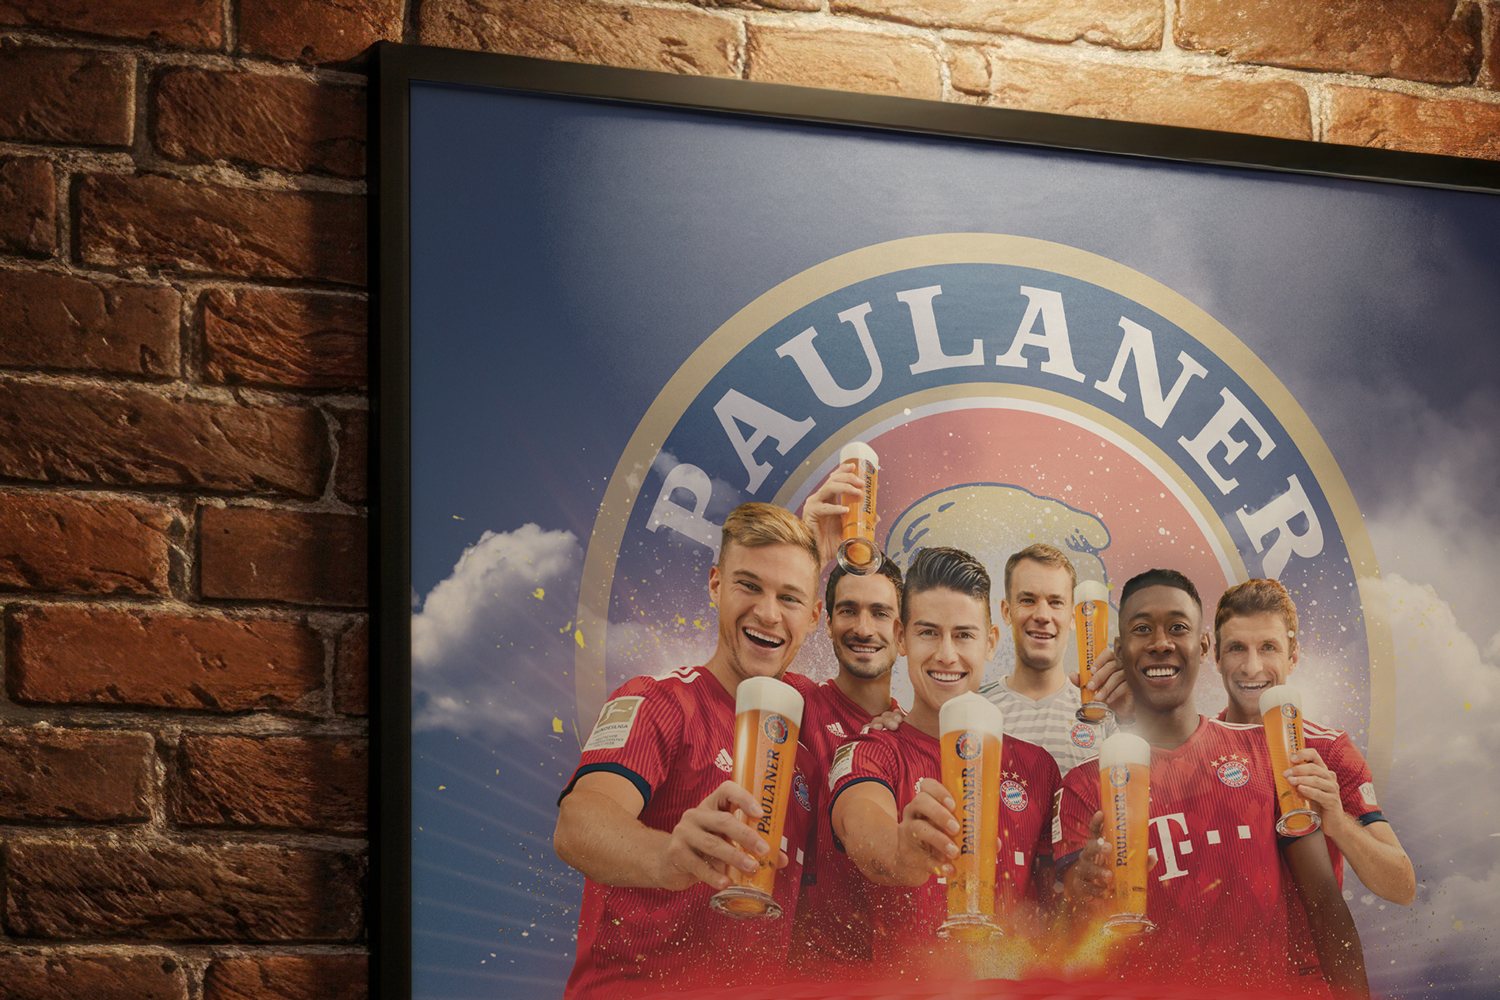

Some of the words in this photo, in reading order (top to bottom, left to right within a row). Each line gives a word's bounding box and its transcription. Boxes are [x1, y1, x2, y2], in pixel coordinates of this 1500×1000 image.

[645, 284, 1325, 580] PAULANER
[756, 748, 781, 835] PAULANER
[961, 767, 976, 856] PAULANER
[1114, 792, 1127, 867] PAULANER
